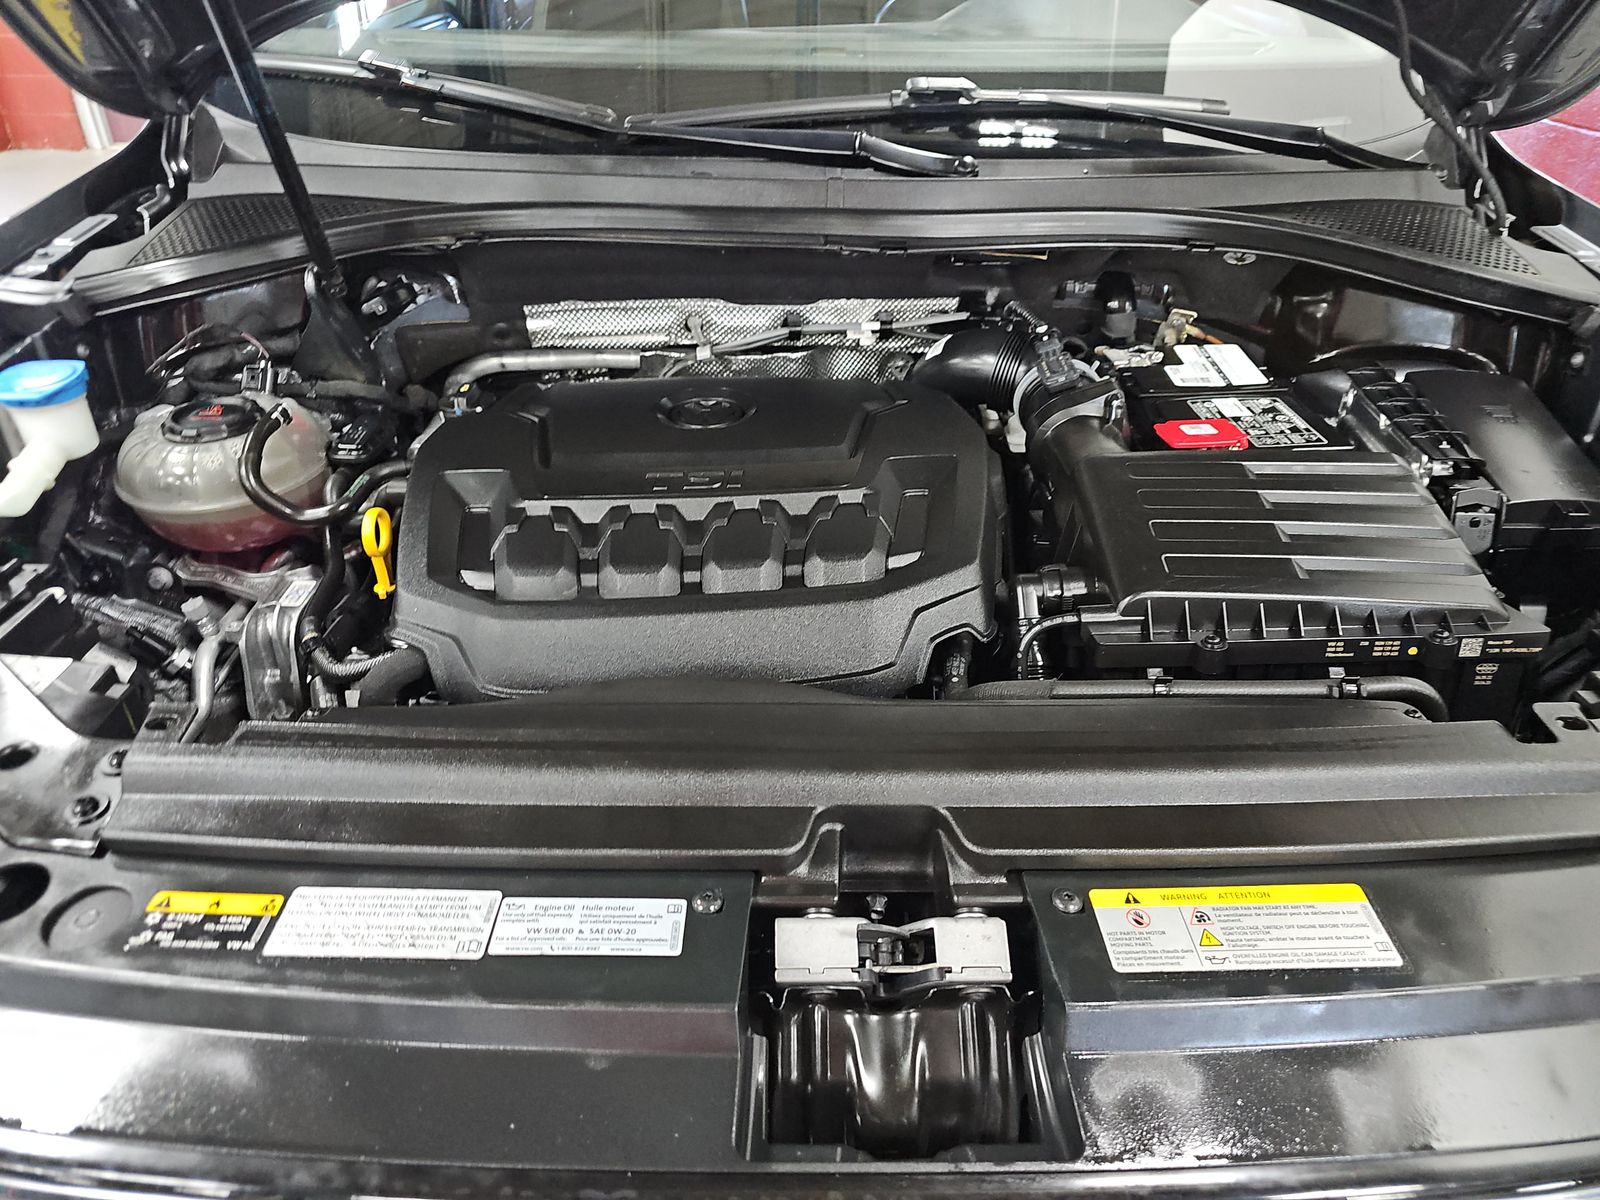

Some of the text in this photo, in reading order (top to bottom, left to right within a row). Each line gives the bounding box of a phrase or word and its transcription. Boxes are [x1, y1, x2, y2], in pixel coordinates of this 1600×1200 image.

[1160, 891, 1271, 901] WARNING ATTENTION
[534, 904, 561, 912] Engine
[428, 925, 485, 933] TRANSMISSION
